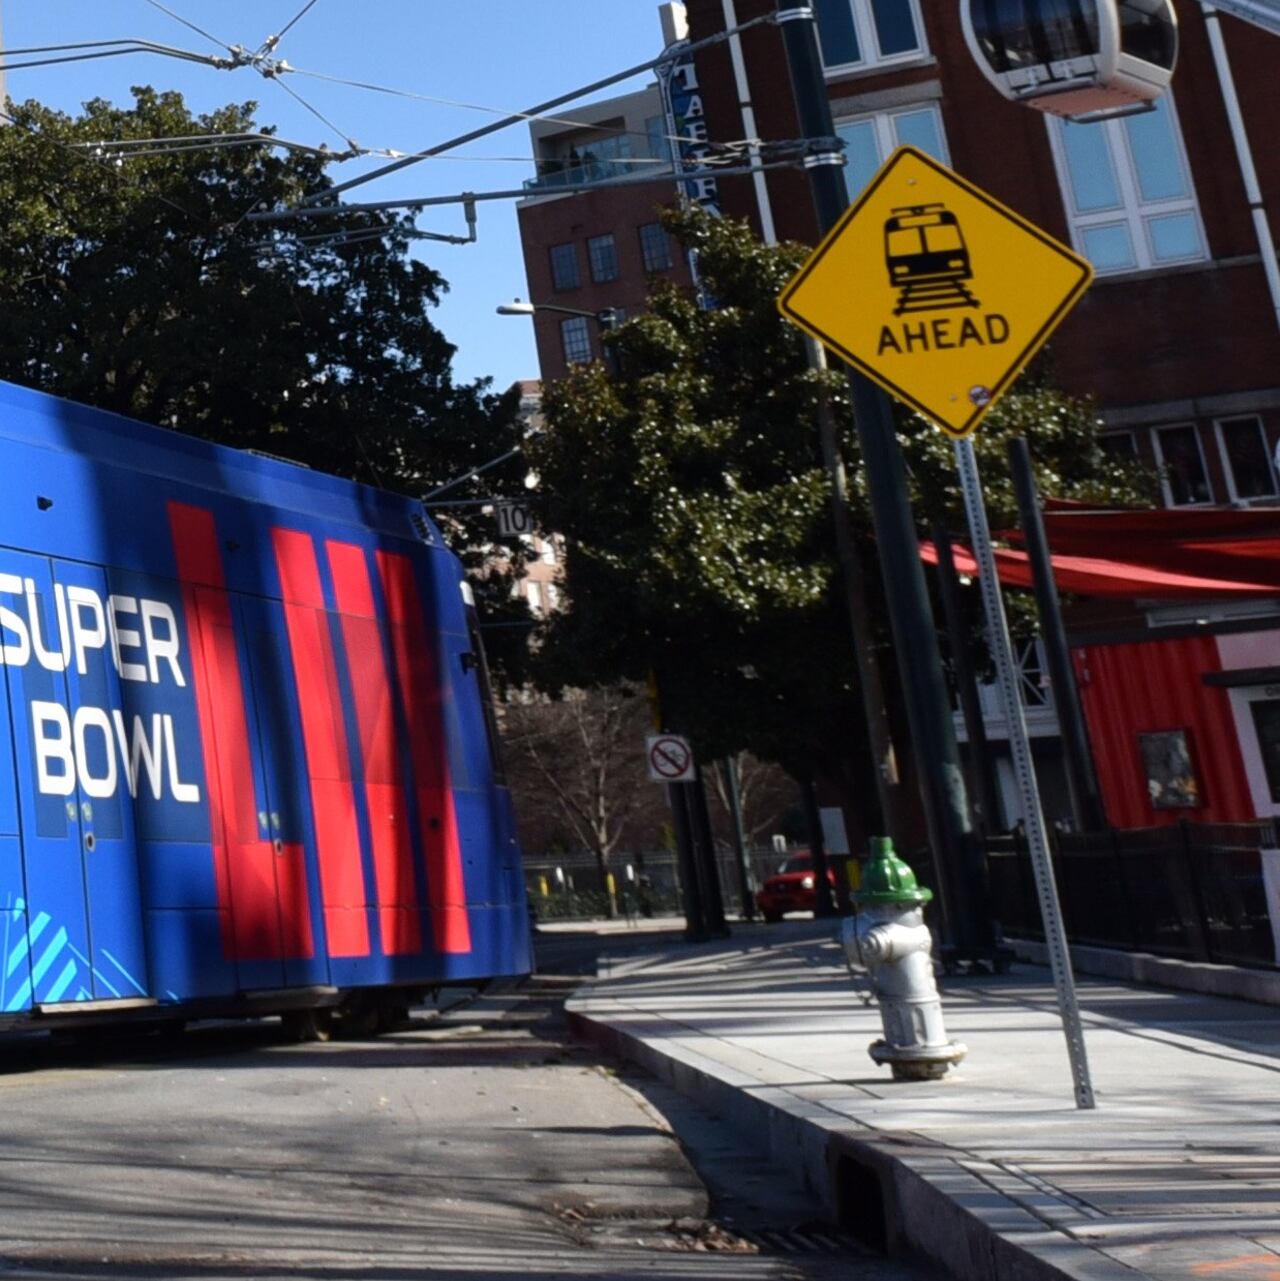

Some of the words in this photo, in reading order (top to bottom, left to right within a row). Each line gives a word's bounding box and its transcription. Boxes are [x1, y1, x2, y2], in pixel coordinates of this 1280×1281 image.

[877, 313, 1010, 356] AHEAD
[500, 506, 528, 532] 10
[31, 700, 201, 803] BOWL
[167, 501, 471, 960] LIII
